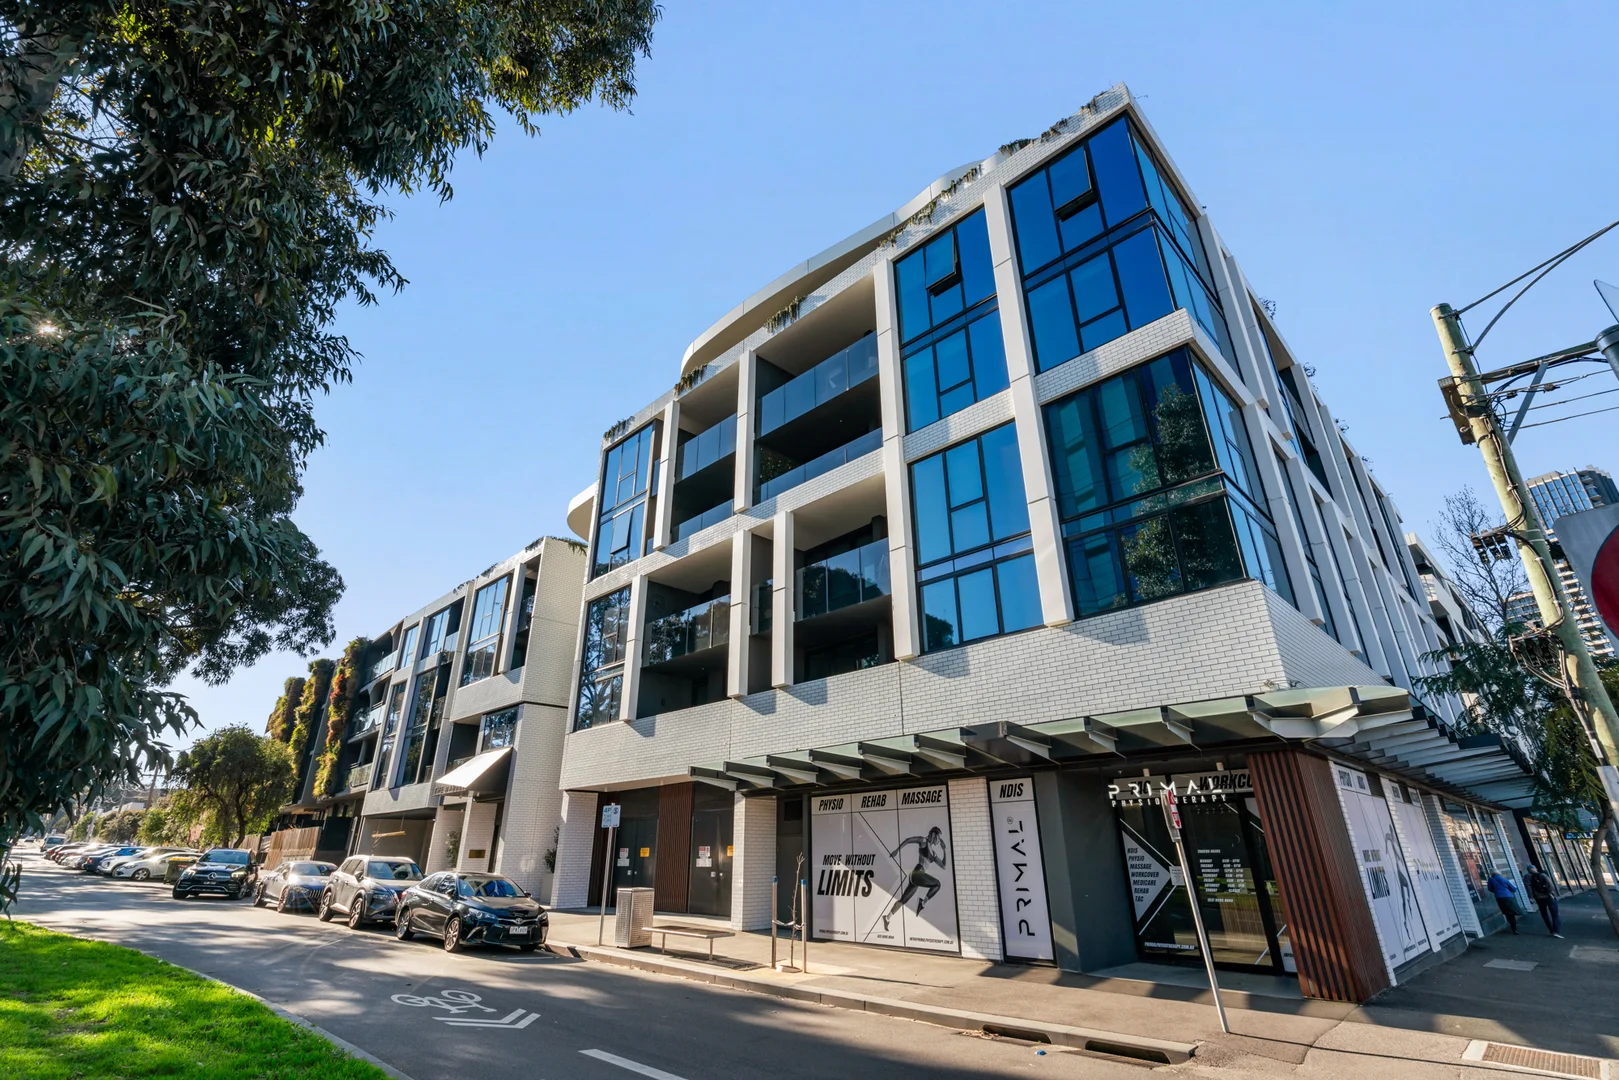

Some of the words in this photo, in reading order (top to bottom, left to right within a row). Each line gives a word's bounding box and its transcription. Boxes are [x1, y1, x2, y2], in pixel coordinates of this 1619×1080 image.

[999, 782, 1024, 798] NDIS
[1108, 778, 1222, 799] PRIMAL
[819, 798, 844, 811] PHYSIO
[861, 794, 887, 808] REHAB
[901, 789, 943, 805] MASSAGE
[822, 854, 842, 866] MOVE
[845, 854, 876, 866] WITHOUT
[817, 869, 875, 898] LIMITS
[1008, 820, 1036, 937] PRIMAL
